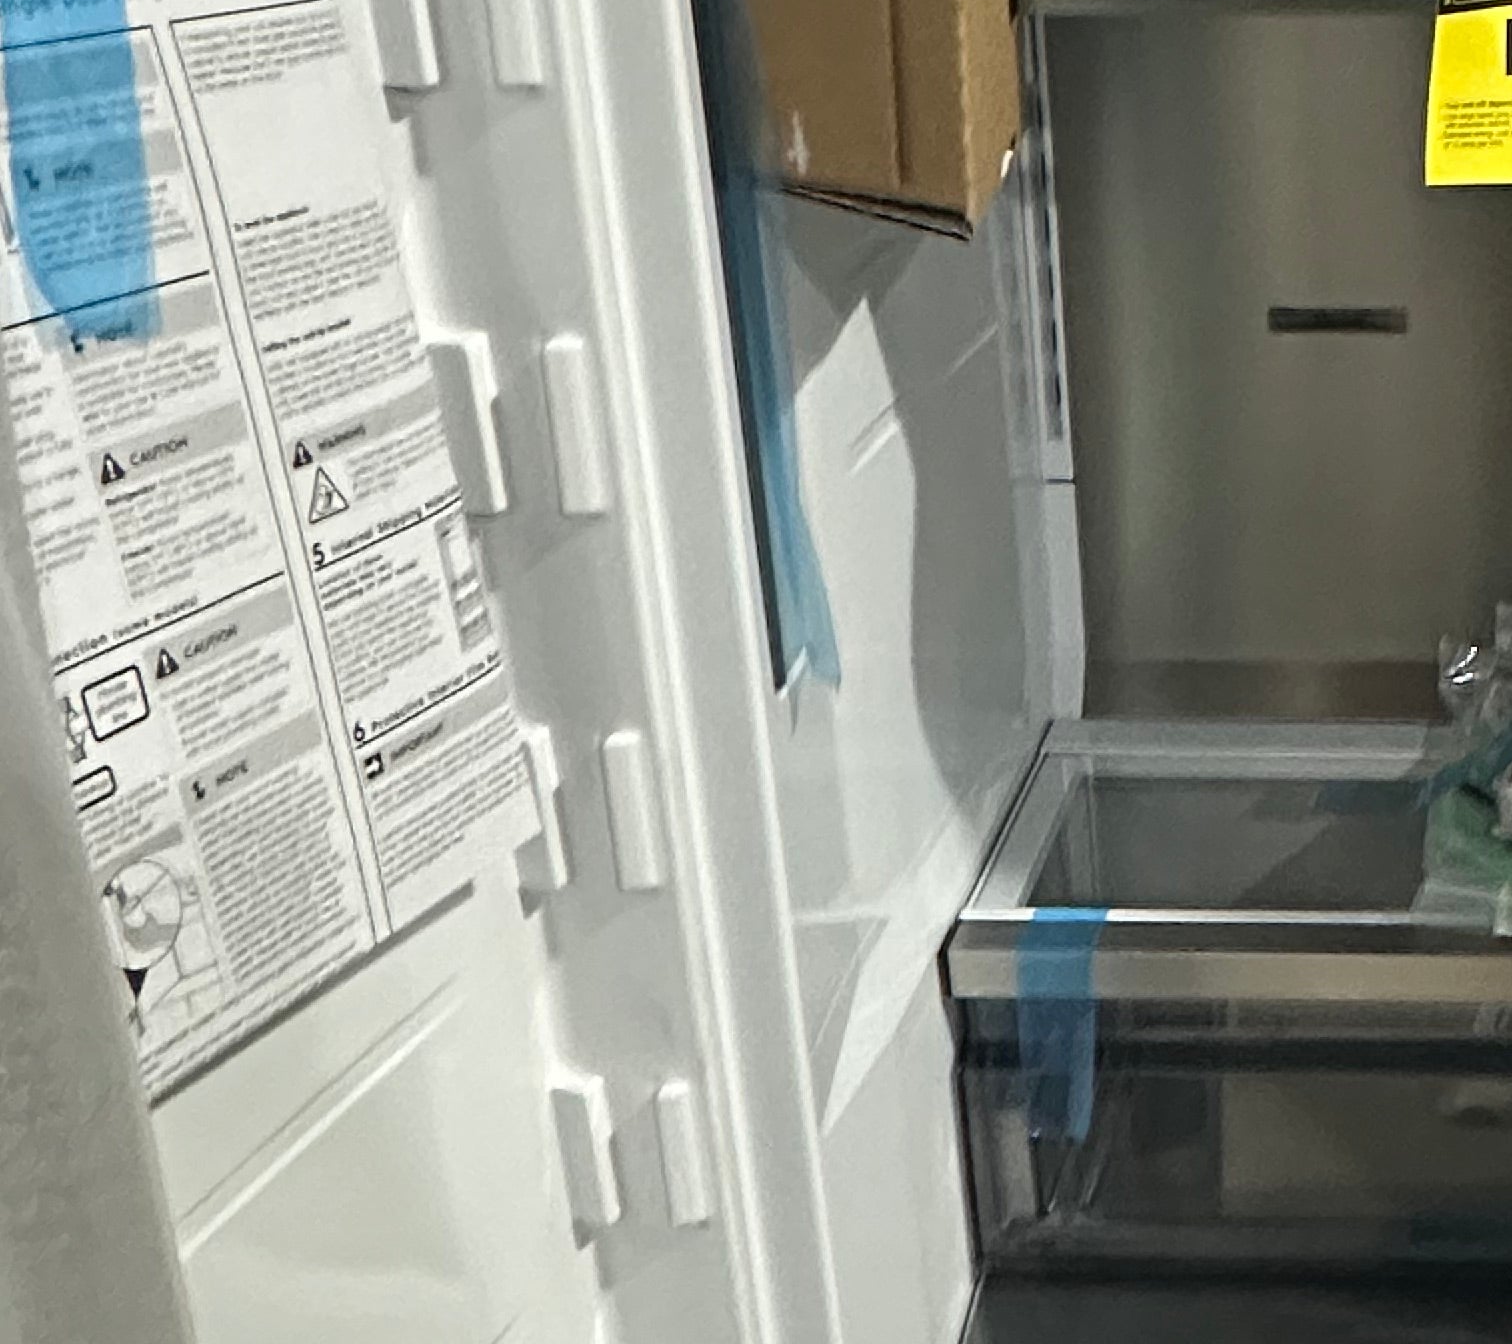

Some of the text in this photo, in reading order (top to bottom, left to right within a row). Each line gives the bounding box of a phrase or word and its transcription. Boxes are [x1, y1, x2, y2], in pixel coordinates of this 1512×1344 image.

[129, 436, 188, 466] CAUTION
[312, 541, 326, 567] 5
[353, 719, 366, 743] 6
